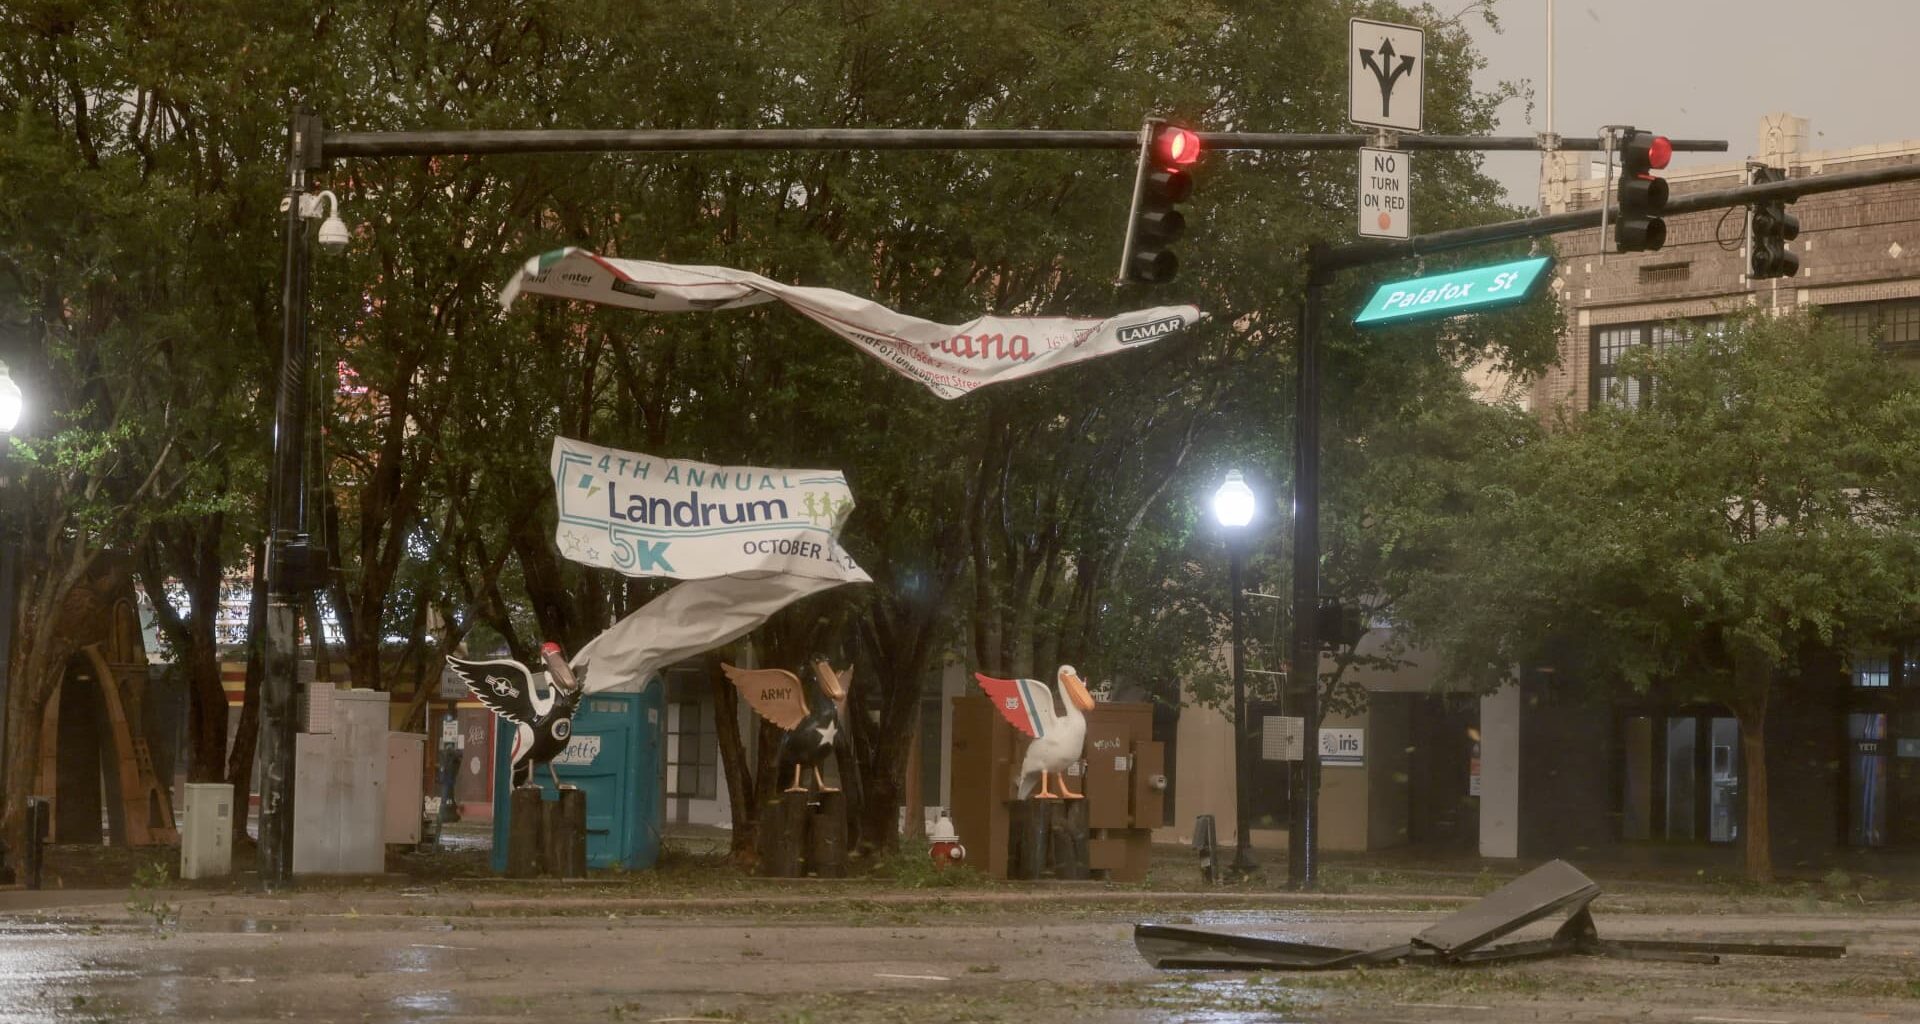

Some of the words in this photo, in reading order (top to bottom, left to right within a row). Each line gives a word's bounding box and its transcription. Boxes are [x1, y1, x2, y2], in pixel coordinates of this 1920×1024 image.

[1374, 155, 1396, 173] NO
[1371, 176, 1399, 191] TURN
[1364, 194, 1379, 207] ON
[1384, 195, 1405, 210] RED
[1381, 282, 1474, 310] Palafox
[1488, 271, 1519, 292] St
[1121, 319, 1181, 342] LAMAR
[597, 454, 650, 480] 4TH
[664, 465, 796, 491] ANNUAL
[608, 481, 788, 528] Landrum
[608, 522, 676, 573] 5K
[742, 539, 822, 561] OCTOBER
[760, 688, 792, 701] ARMY
[1339, 734, 1359, 751] iris
